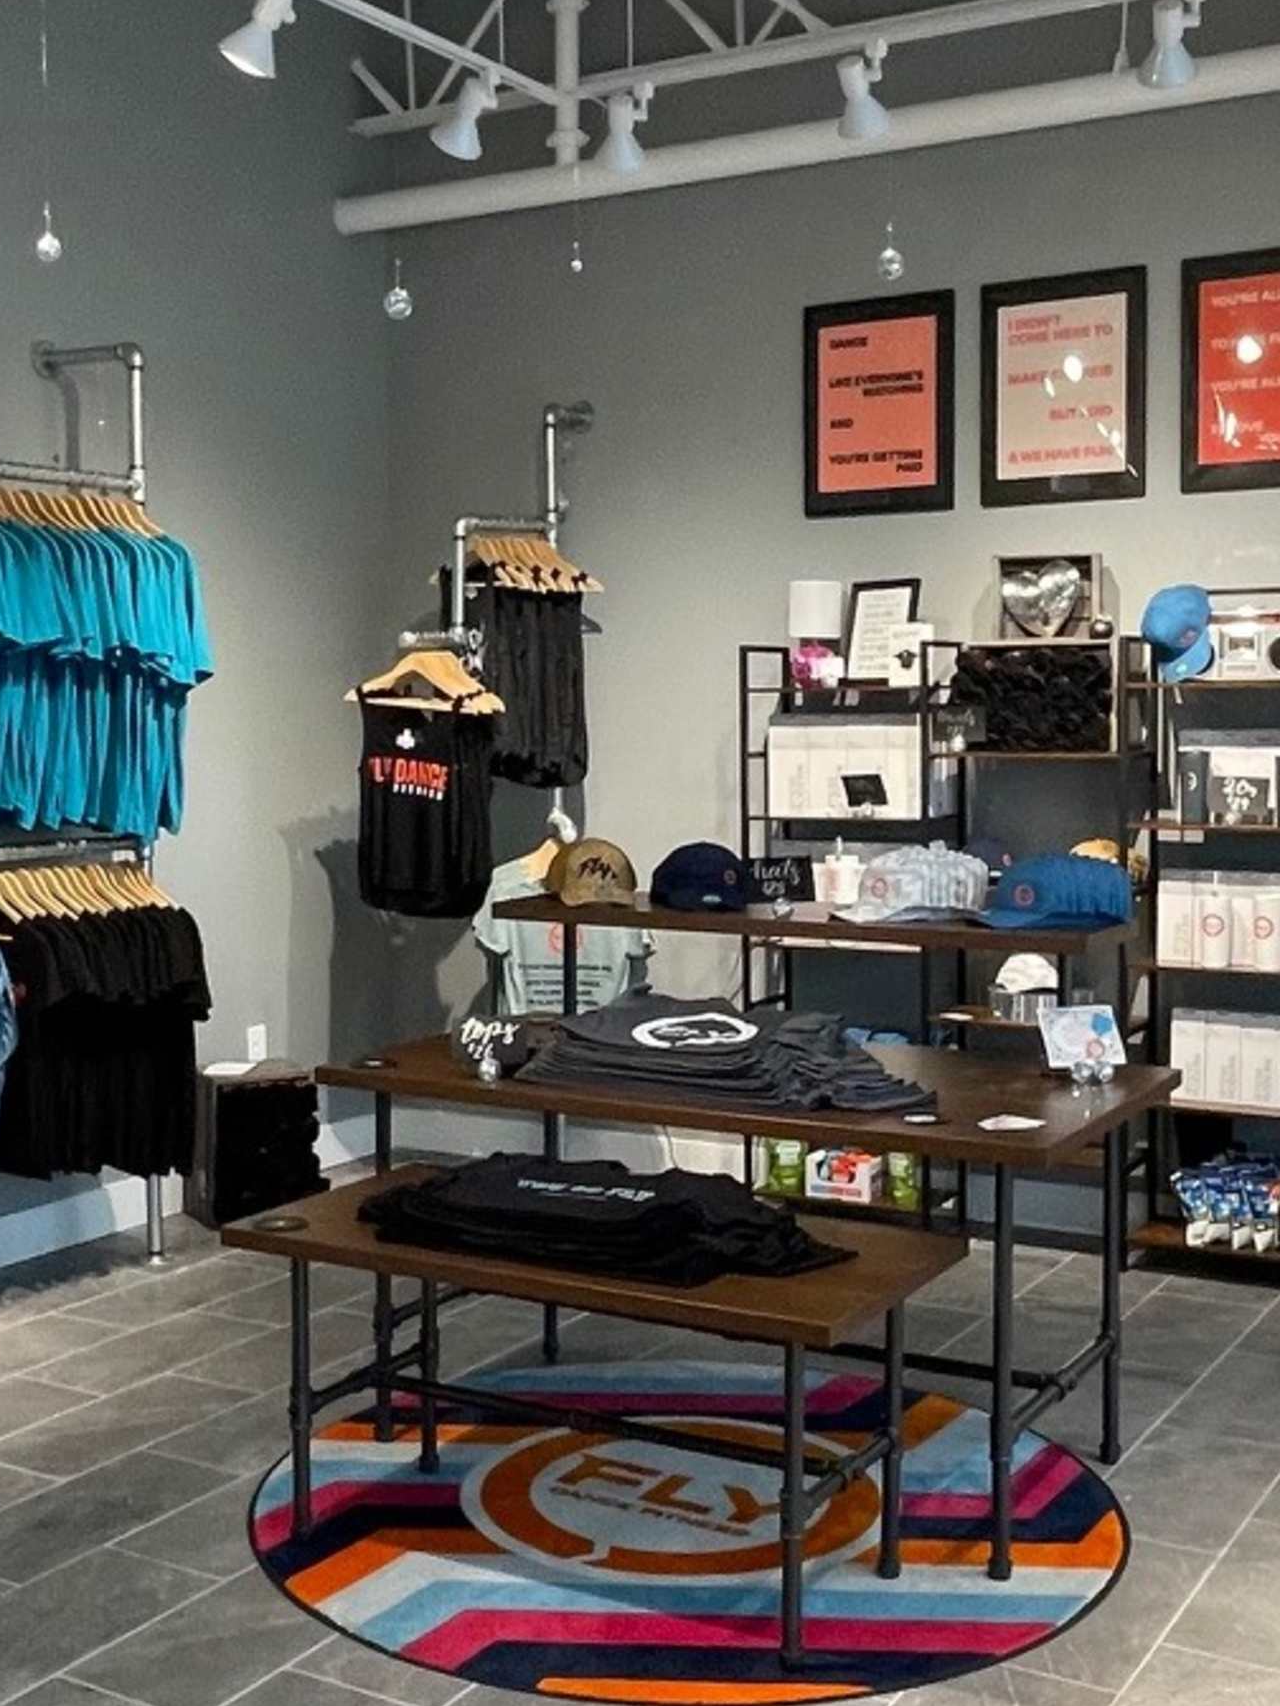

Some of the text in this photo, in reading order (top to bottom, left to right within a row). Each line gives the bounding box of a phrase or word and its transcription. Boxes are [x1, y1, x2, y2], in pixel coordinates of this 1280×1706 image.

[1211, 292, 1259, 307] YOU'RE
[1094, 324, 1113, 336] TO
[1211, 377, 1259, 392] YOU'RE
[872, 449, 923, 462] GETTING
[896, 462, 923, 473] PAID
[460, 1017, 521, 1045] tops
[556, 1453, 783, 1526] FLY
